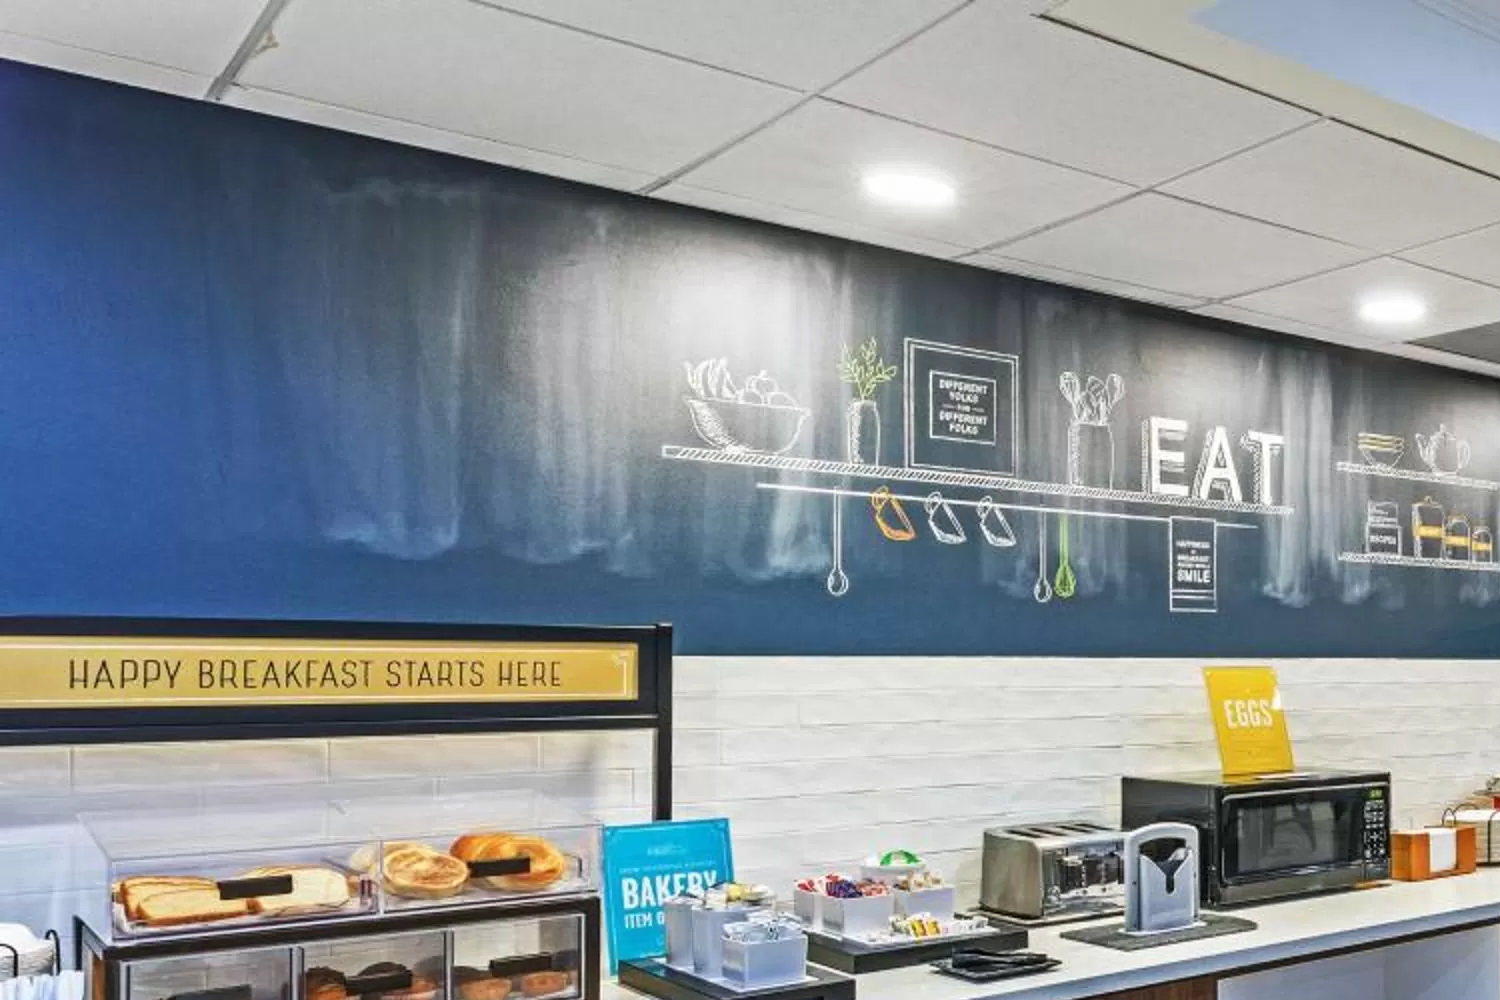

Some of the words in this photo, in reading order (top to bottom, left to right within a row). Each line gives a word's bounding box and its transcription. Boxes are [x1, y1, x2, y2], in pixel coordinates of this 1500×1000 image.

[939, 379, 988, 394] DIFFERENT
[939, 410, 988, 426] DIFFERENT
[949, 422, 979, 435] FOLKS
[1142, 416, 1285, 505] EAT
[1177, 569, 1211, 583] SMILE
[69, 659, 181, 689] HAPPY
[198, 659, 374, 689] BREAKFAST
[386, 660, 484, 688] STARTS
[498, 661, 561, 687] HERE
[1223, 699, 1274, 730] EGGS
[624, 912, 652, 929] ITEM
